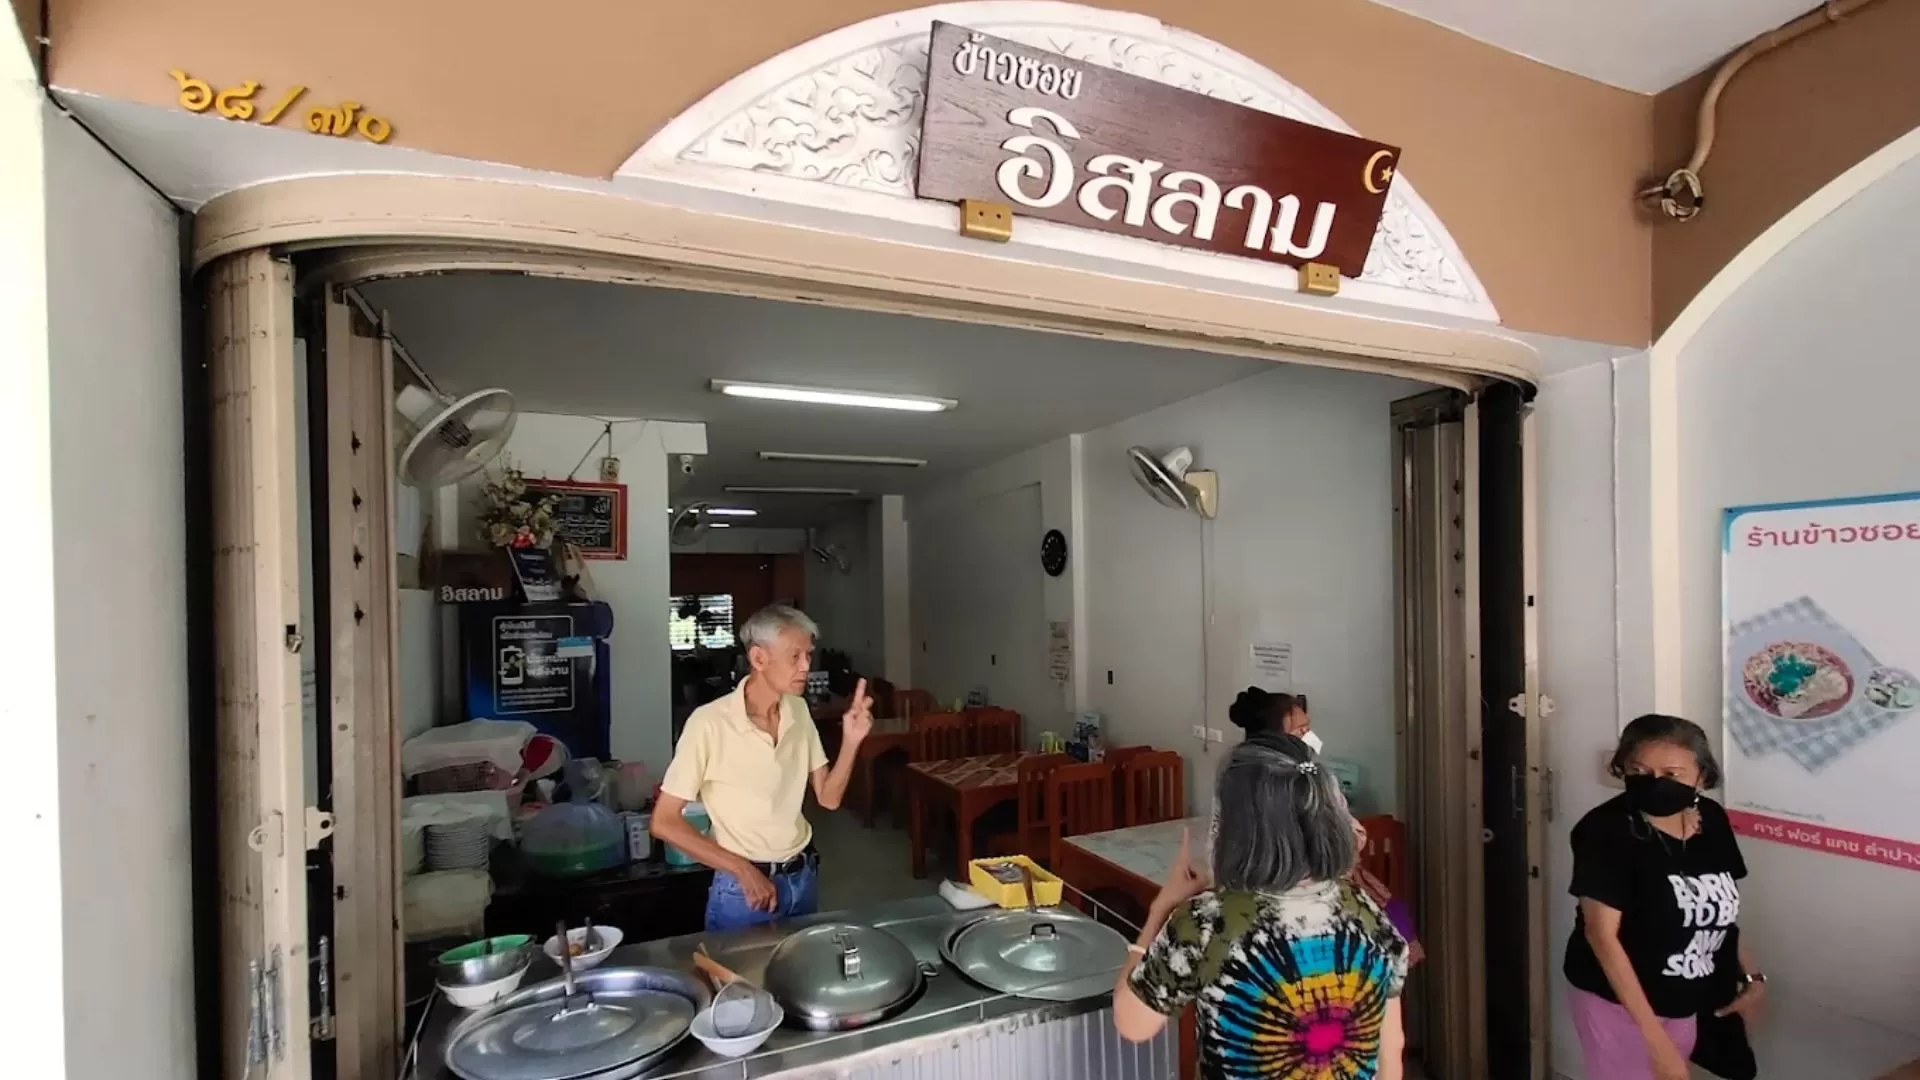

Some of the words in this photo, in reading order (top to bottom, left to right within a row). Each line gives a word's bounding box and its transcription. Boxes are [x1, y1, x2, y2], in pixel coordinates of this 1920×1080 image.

[953, 32, 1083, 100] ข้าวซอย
[996, 106, 1337, 260] อิสลาม
[441, 585, 504, 602] อิสลาม
[1667, 871, 1740, 903] BORN
[1678, 901, 1716, 927] TO
